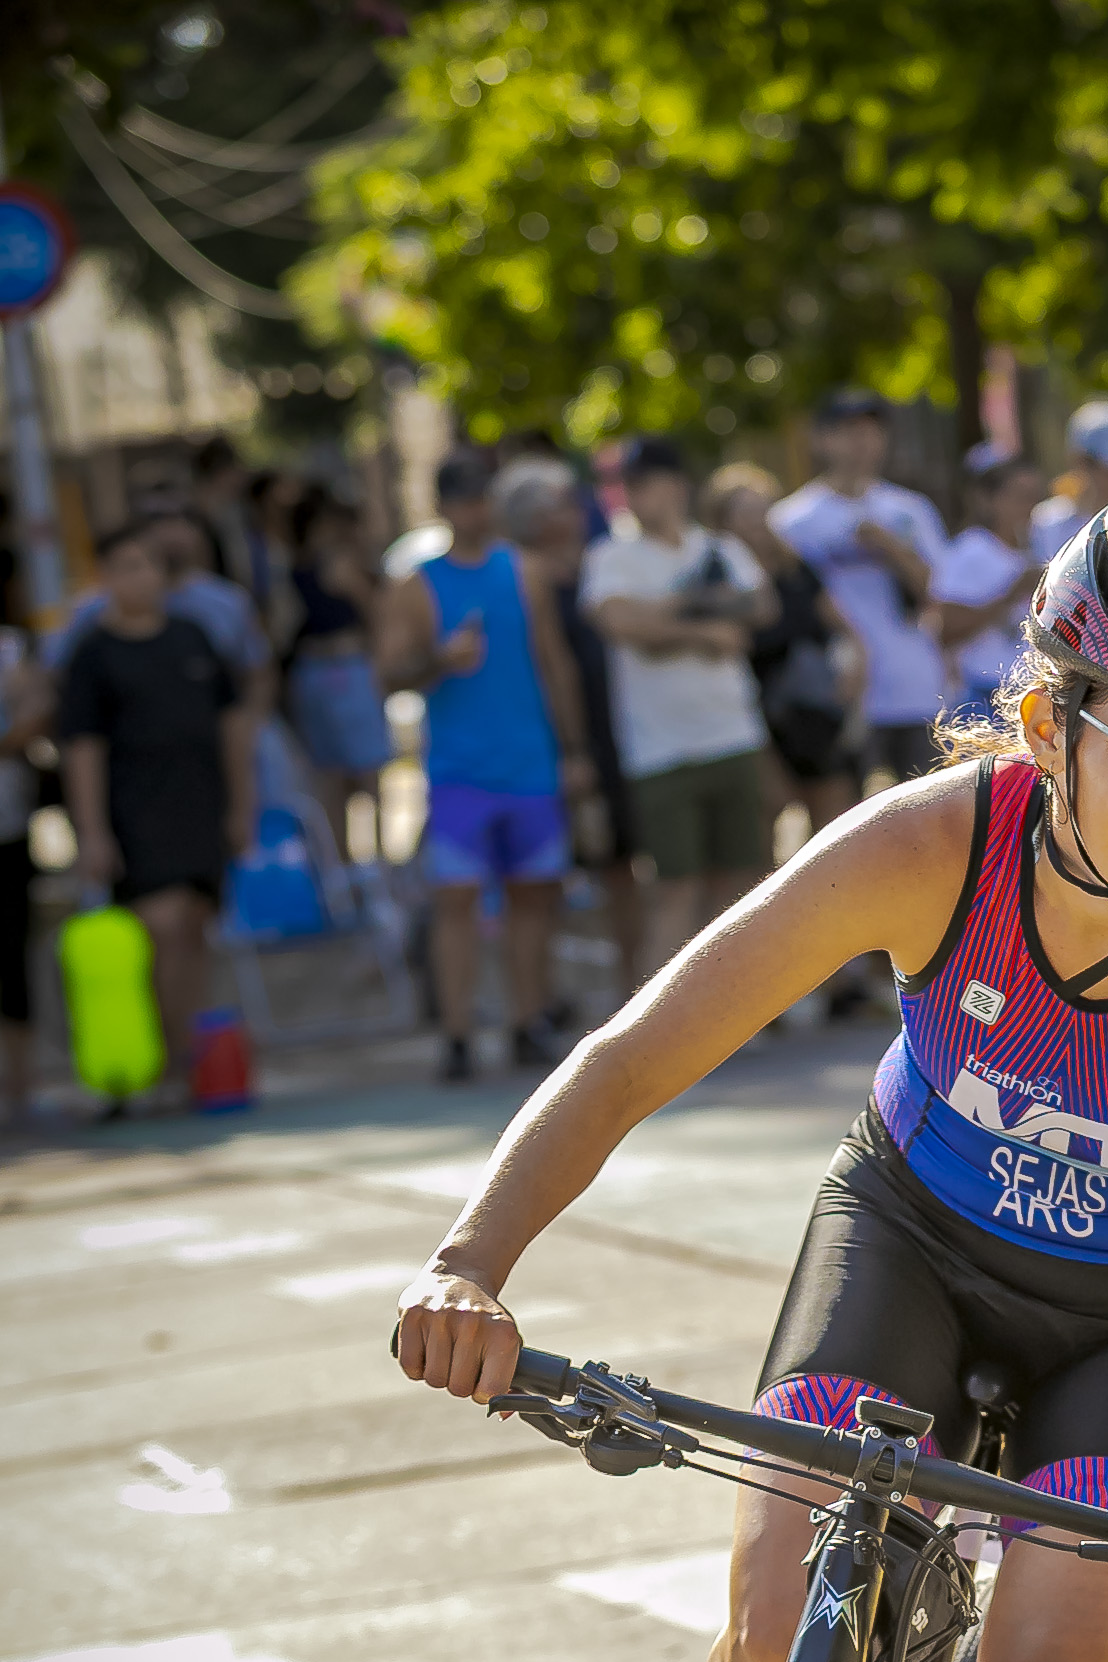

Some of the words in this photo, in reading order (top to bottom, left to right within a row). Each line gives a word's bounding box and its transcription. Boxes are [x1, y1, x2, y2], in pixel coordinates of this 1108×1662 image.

[966, 1053, 1062, 1106] triathlon
[988, 1146, 1107, 1213] SEJAS
[993, 1188, 1094, 1238] ARG
